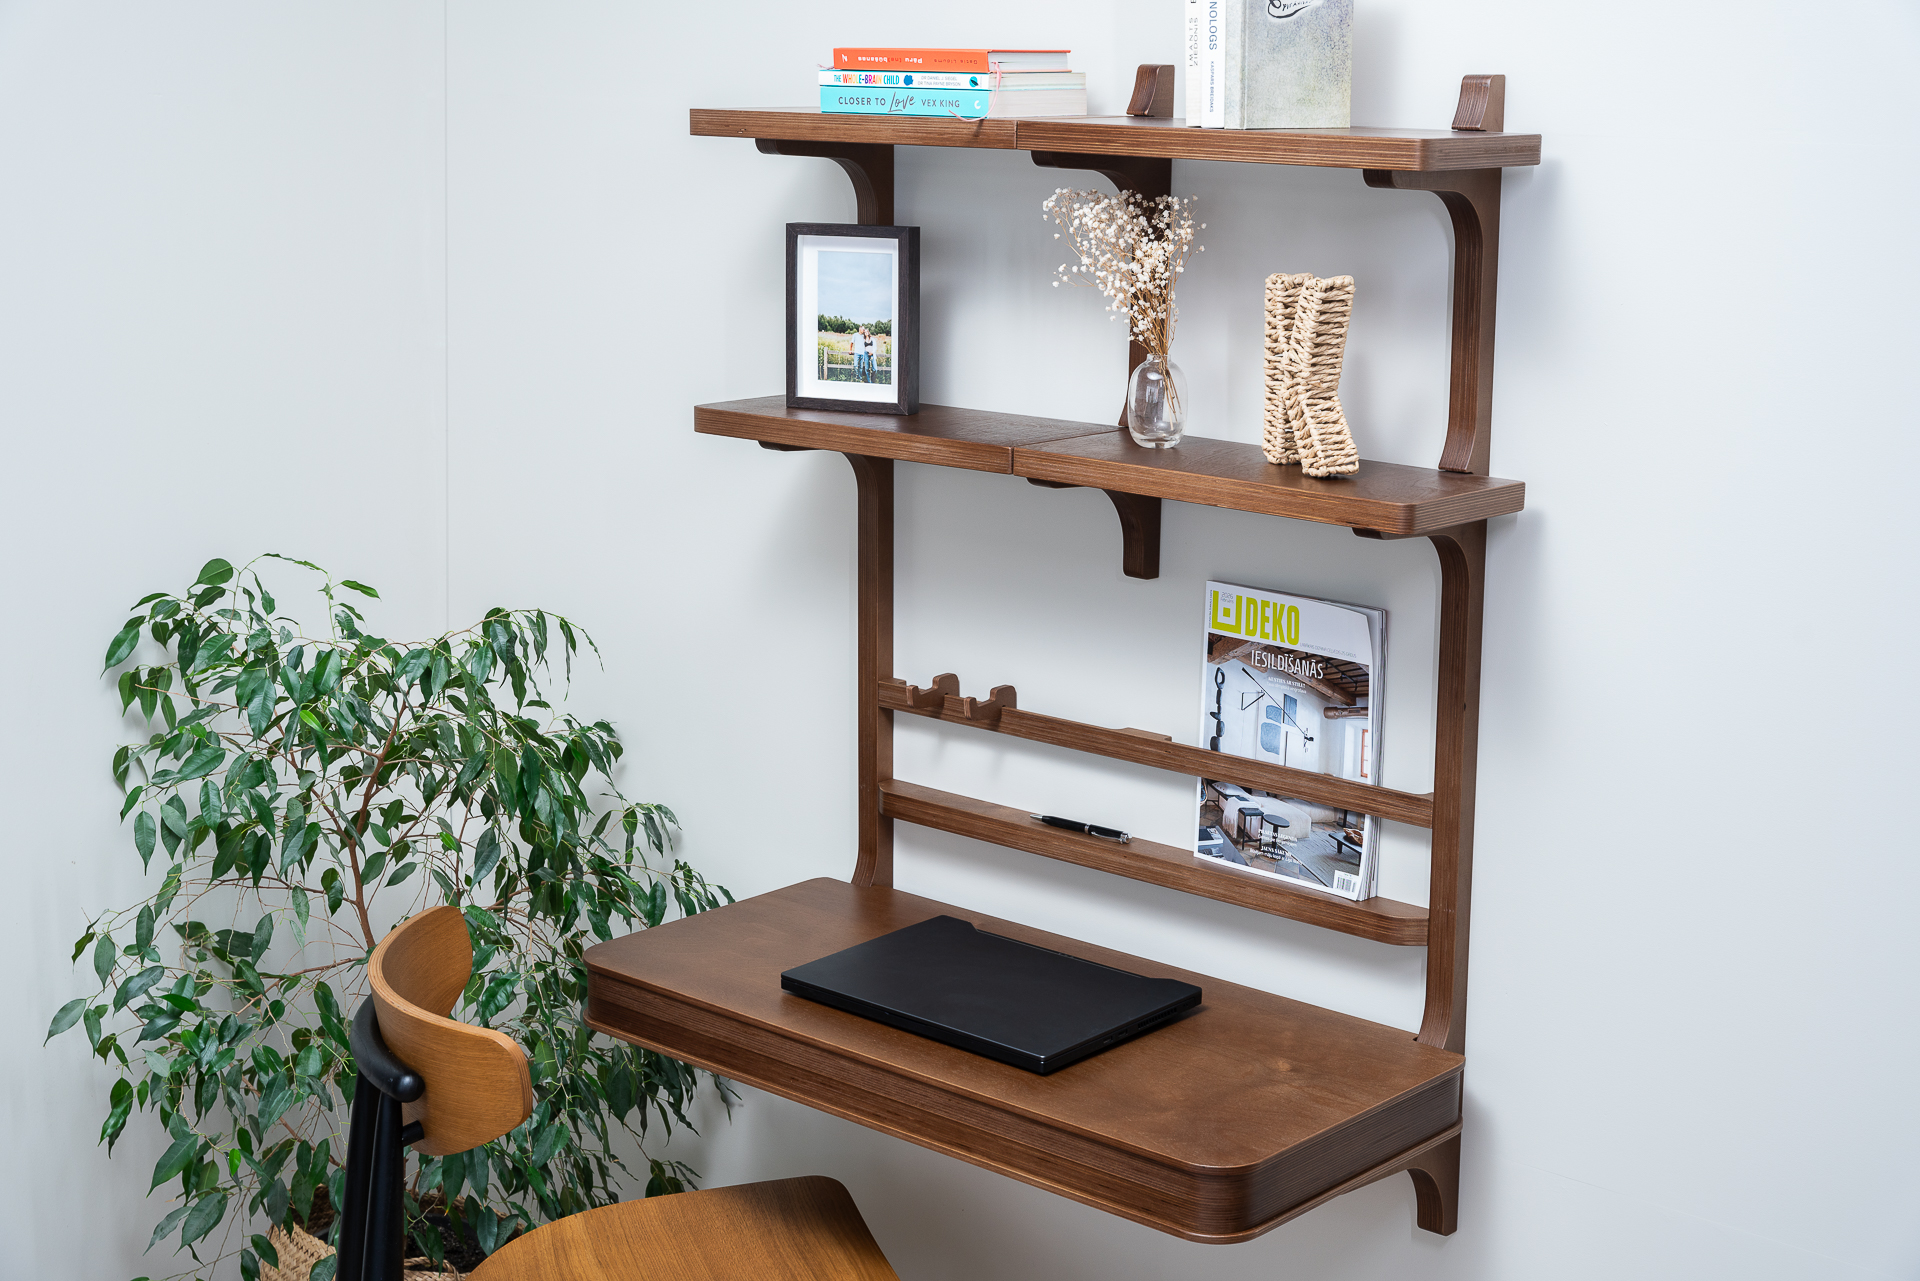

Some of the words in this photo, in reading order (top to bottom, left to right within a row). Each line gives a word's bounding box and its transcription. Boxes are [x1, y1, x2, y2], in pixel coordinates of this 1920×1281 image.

[833, 74, 842, 83] THE
[842, 74, 882, 85] WHOLE-BRAIN
[883, 75, 900, 85] CHILD
[838, 96, 872, 106] CLOSER
[875, 97, 886, 106] TO
[887, 91, 916, 113] Love
[921, 99, 937, 107] VEX
[939, 99, 960, 108] KING
[1244, 596, 1300, 646] DEKO
[1251, 649, 1324, 680] IESILDĪŠANĀS
